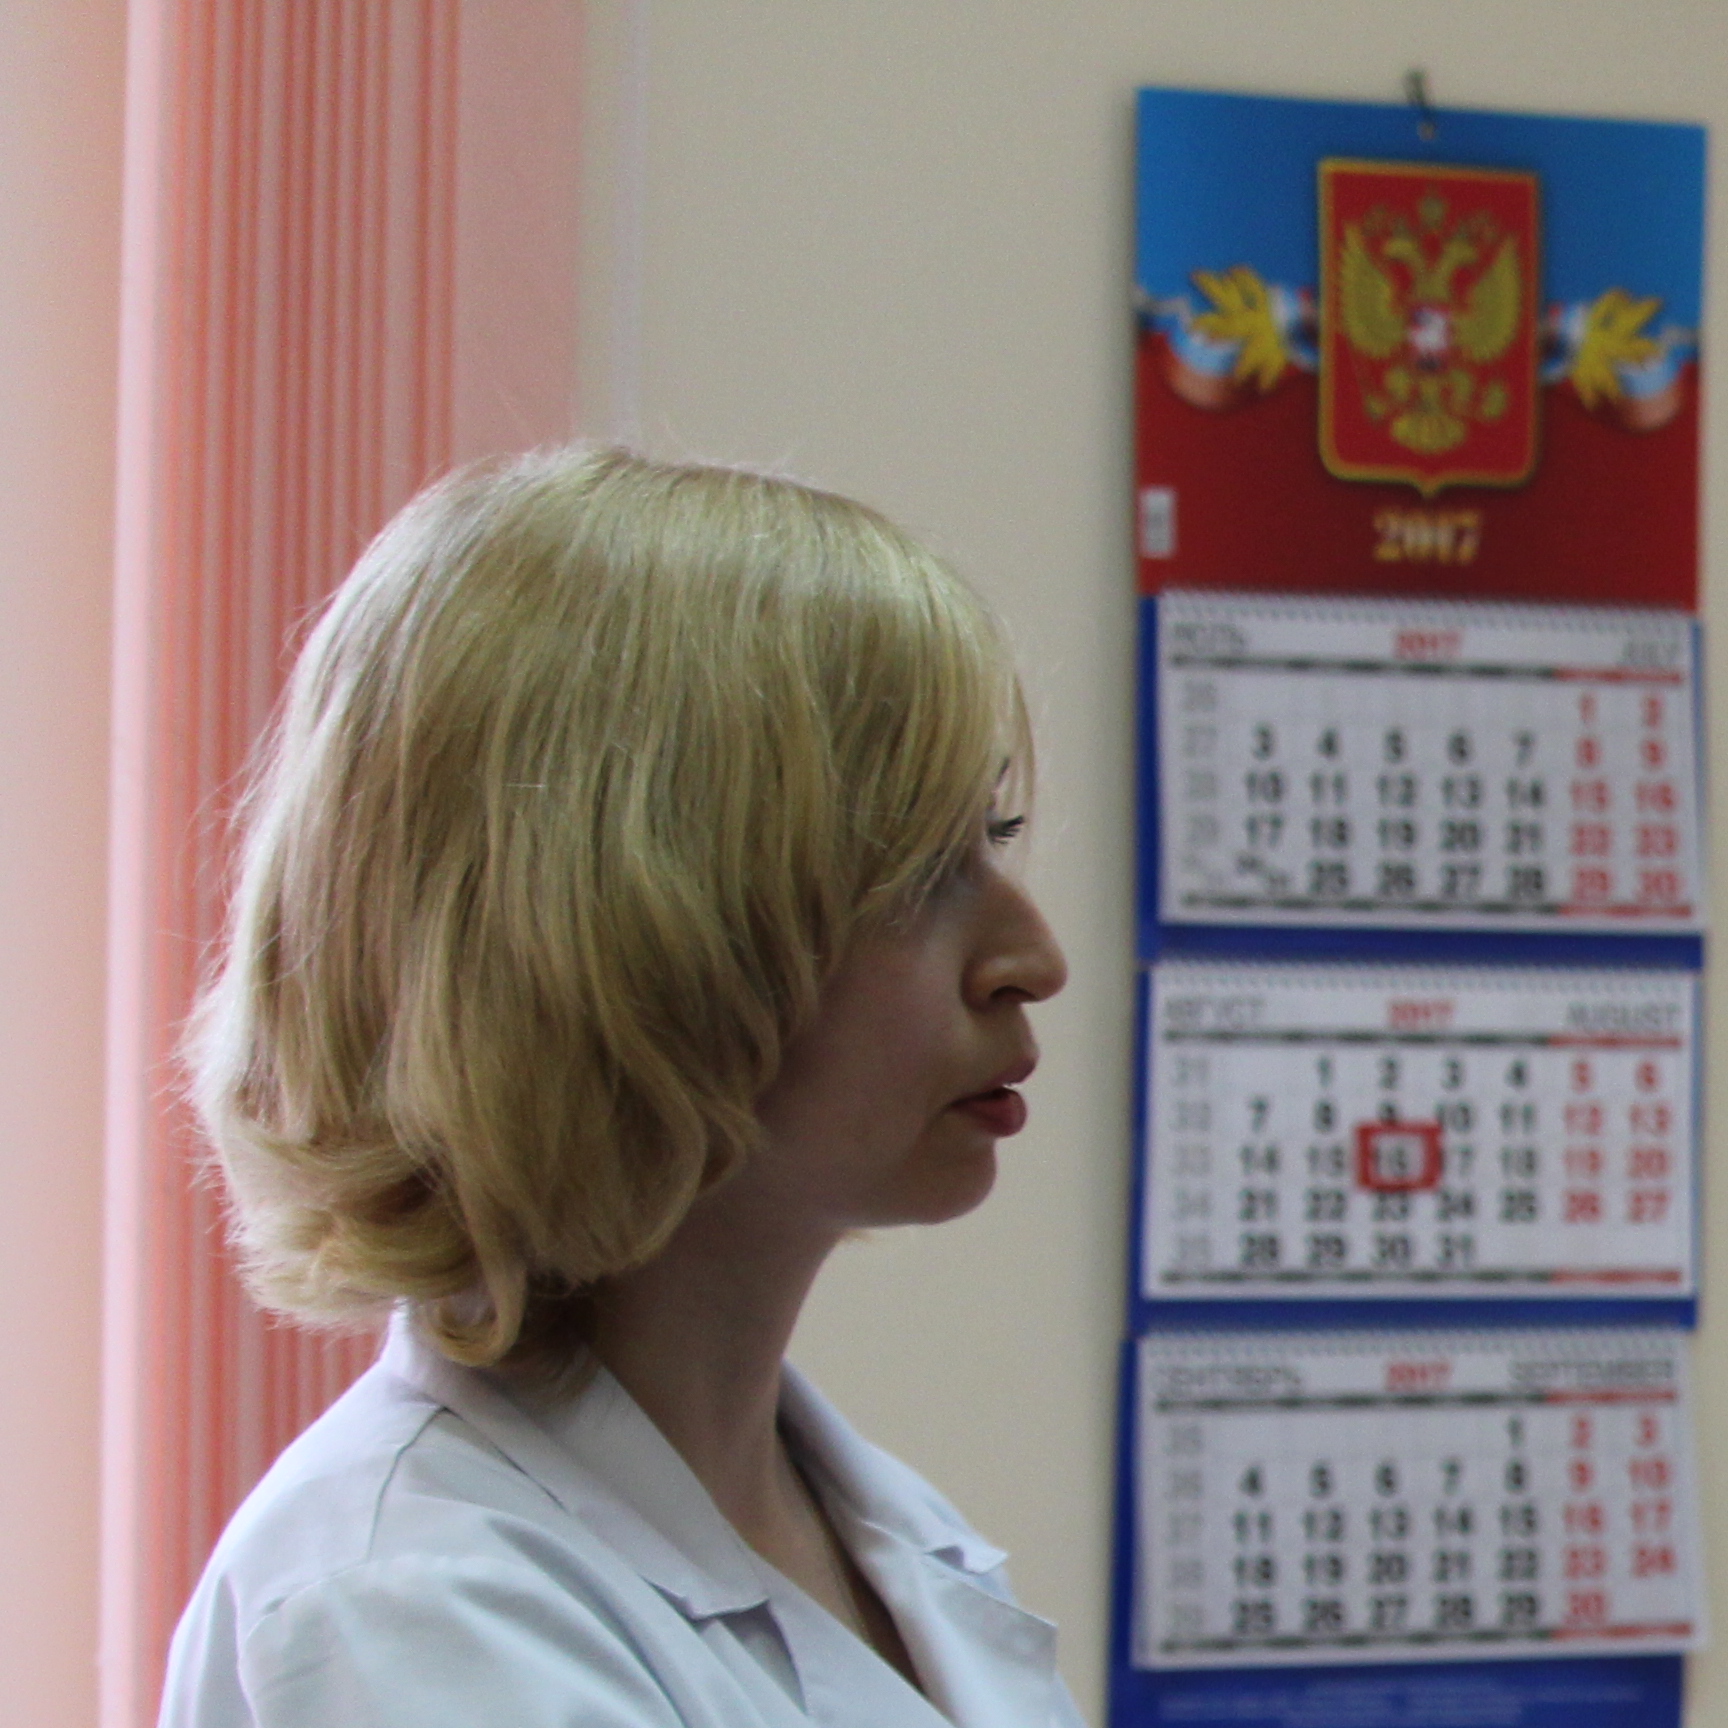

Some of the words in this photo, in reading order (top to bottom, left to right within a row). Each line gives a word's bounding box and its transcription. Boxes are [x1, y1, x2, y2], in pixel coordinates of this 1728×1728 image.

[1373, 509, 1483, 564] 2017
[1395, 630, 1463, 659] 2017
[1579, 689, 1599, 727] 1
[1642, 690, 1666, 728] 2
[1253, 724, 1277, 762] 3
[1318, 726, 1342, 764] 4
[1383, 727, 1407, 765] 5
[1448, 729, 1472, 767] 6
[1513, 731, 1537, 769] 7
[1244, 768, 1287, 806] 10
[1309, 769, 1352, 807] 11
[1374, 771, 1417, 809] 12
[1439, 773, 1482, 811] 13
[1504, 775, 1547, 813] 14
[1569, 776, 1612, 814] 15
[1634, 778, 1677, 816] 16
[1244, 812, 1287, 850] 17
[1309, 813, 1352, 851] 18
[1374, 815, 1417, 853] 19
[1439, 817, 1482, 855] 20
[1504, 819, 1547, 857] 21
[1570, 820, 1613, 858] 22
[1635, 822, 1678, 860] 23
[1310, 857, 1353, 895] 25
[1375, 859, 1418, 897] 26
[1440, 861, 1483, 899] 27
[1505, 863, 1548, 901] 28
[1570, 864, 1613, 902] 29
[1636, 866, 1679, 904] 30
[1387, 999, 1455, 1028] 2017
[1314, 1053, 1334, 1091] 1
[1378, 1054, 1402, 1092] 2
[1443, 1054, 1467, 1092] 3
[1508, 1055, 1532, 1093] 4
[1247, 1097, 1271, 1135] 7
[1312, 1097, 1336, 1135] 8
[1433, 1099, 1473, 1134] 10
[1498, 1099, 1541, 1137] 11
[1562, 1100, 1605, 1138] 12
[1627, 1100, 1670, 1138] 13
[1237, 1141, 1280, 1179] 14
[1303, 1142, 1346, 1180] 15
[1498, 1143, 1541, 1181] 18
[1562, 1143, 1605, 1181] 19
[1627, 1144, 1670, 1182] 20
[1237, 1186, 1280, 1224] 21
[1303, 1186, 1346, 1224] 22
[1435, 1186, 1476, 1222] 24
[1498, 1187, 1541, 1225] 25
[1562, 1187, 1605, 1225] 26
[1627, 1188, 1670, 1226] 27
[1237, 1230, 1280, 1268] 28
[1303, 1230, 1346, 1268] 29
[1368, 1231, 1411, 1269] 30
[1433, 1231, 1476, 1269] 31
[1385, 1362, 1453, 1392] 2017
[1507, 1412, 1527, 1450] 1
[1571, 1411, 1595, 1449] 2
[1241, 1462, 1265, 1500] 4
[1307, 1461, 1331, 1499] 5
[1374, 1459, 1398, 1497] 6
[1440, 1458, 1464, 1496] 7
[1506, 1456, 1530, 1494] 8
[1628, 1454, 1671, 1492] 10
[1232, 1507, 1275, 1545] 11
[1299, 1506, 1342, 1544] 12
[1365, 1504, 1408, 1542] 13
[1431, 1503, 1474, 1541] 14
[1497, 1501, 1540, 1539] 15
[1563, 1499, 1606, 1537] 16
[1629, 1498, 1672, 1536] 17
[1233, 1552, 1276, 1590] 18
[1299, 1550, 1342, 1588] 19
[1366, 1549, 1409, 1587] 20
[1432, 1547, 1475, 1585] 21
[1498, 1546, 1541, 1584] 22
[1564, 1544, 1607, 1582] 23
[1629, 1542, 1672, 1580] 24
[1234, 1597, 1277, 1635] 25
[1300, 1595, 1343, 1633] 26
[1367, 1594, 1410, 1632] 27
[1433, 1592, 1476, 1630] 28
[1499, 1590, 1542, 1628] 29
[1565, 1588, 1608, 1626] 30
